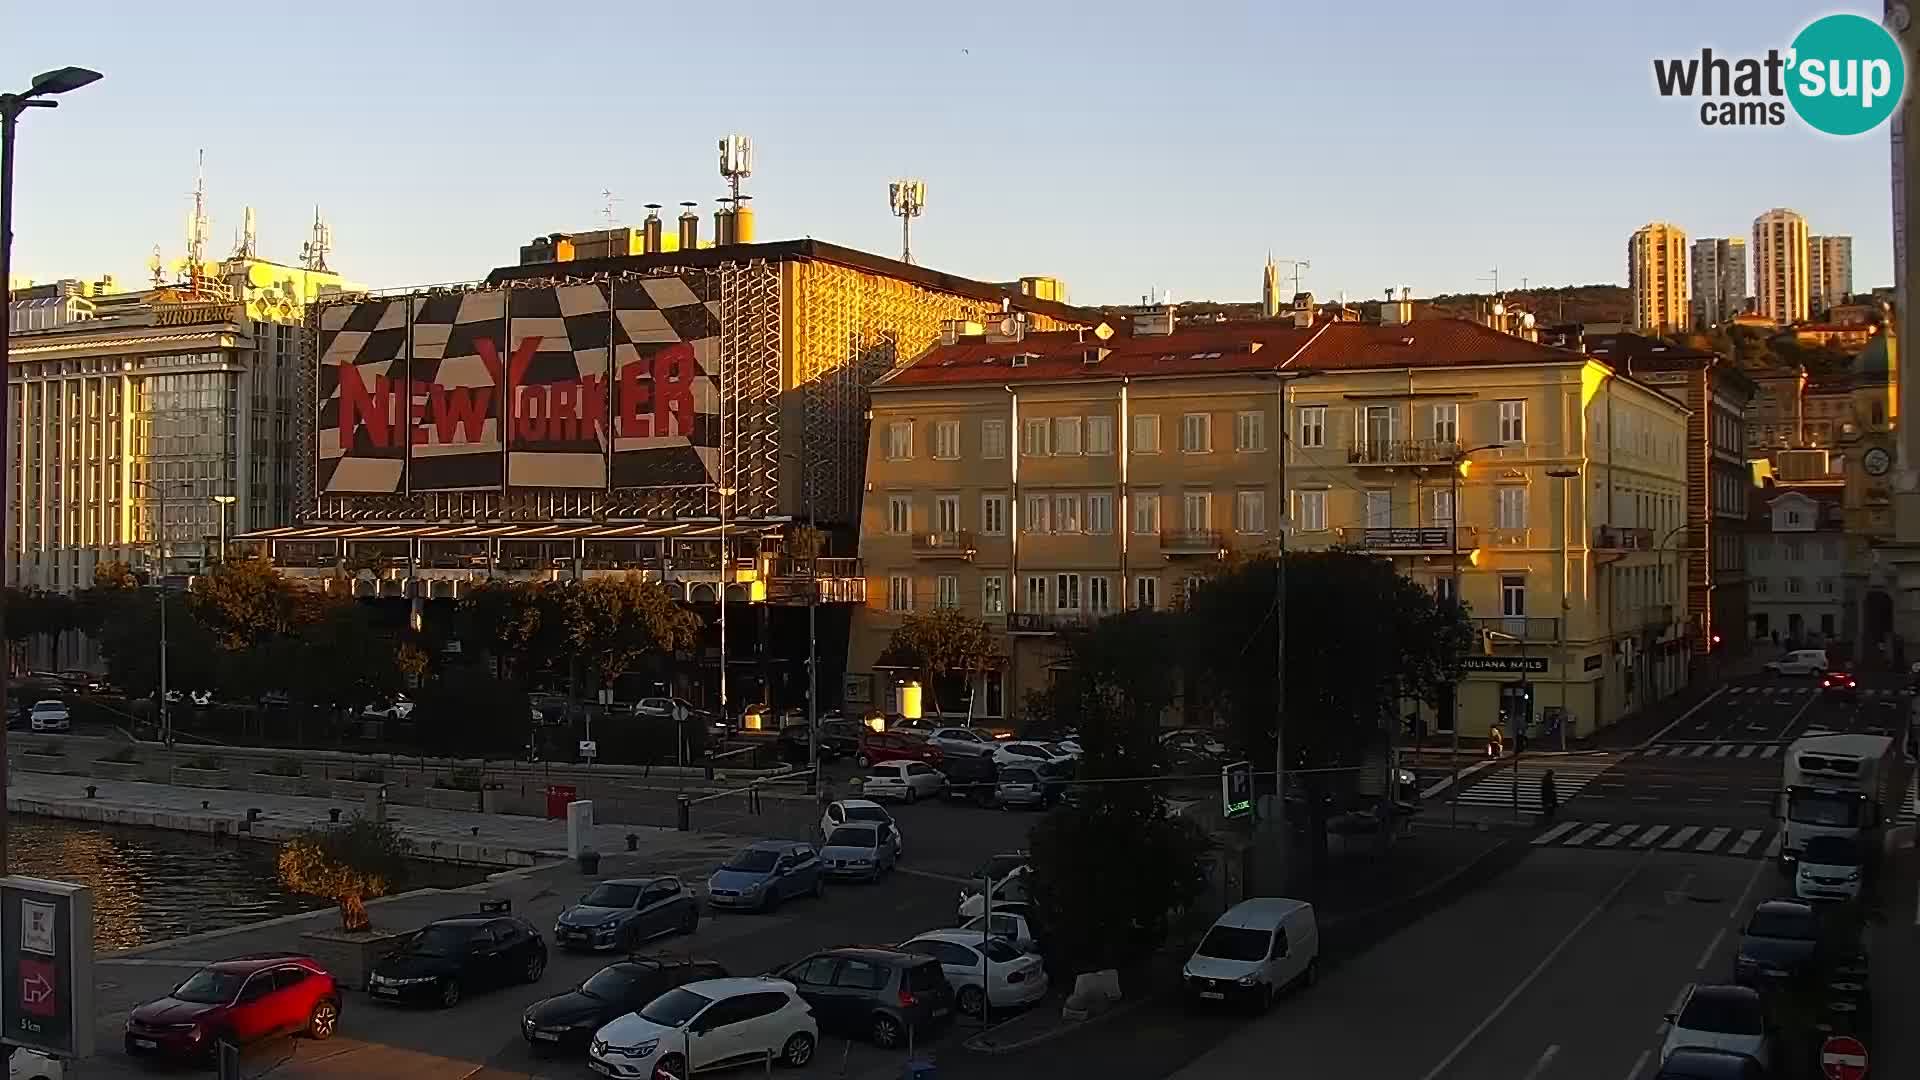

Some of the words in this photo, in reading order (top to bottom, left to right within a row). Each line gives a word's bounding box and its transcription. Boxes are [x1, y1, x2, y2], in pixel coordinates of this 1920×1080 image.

[339, 359, 492, 449] NEW
[1460, 659, 1507, 669] JULIANA
[1510, 659, 1542, 669] NAILS
[20, 1018, 27, 1030] 5
[28, 1019, 41, 1032] km
